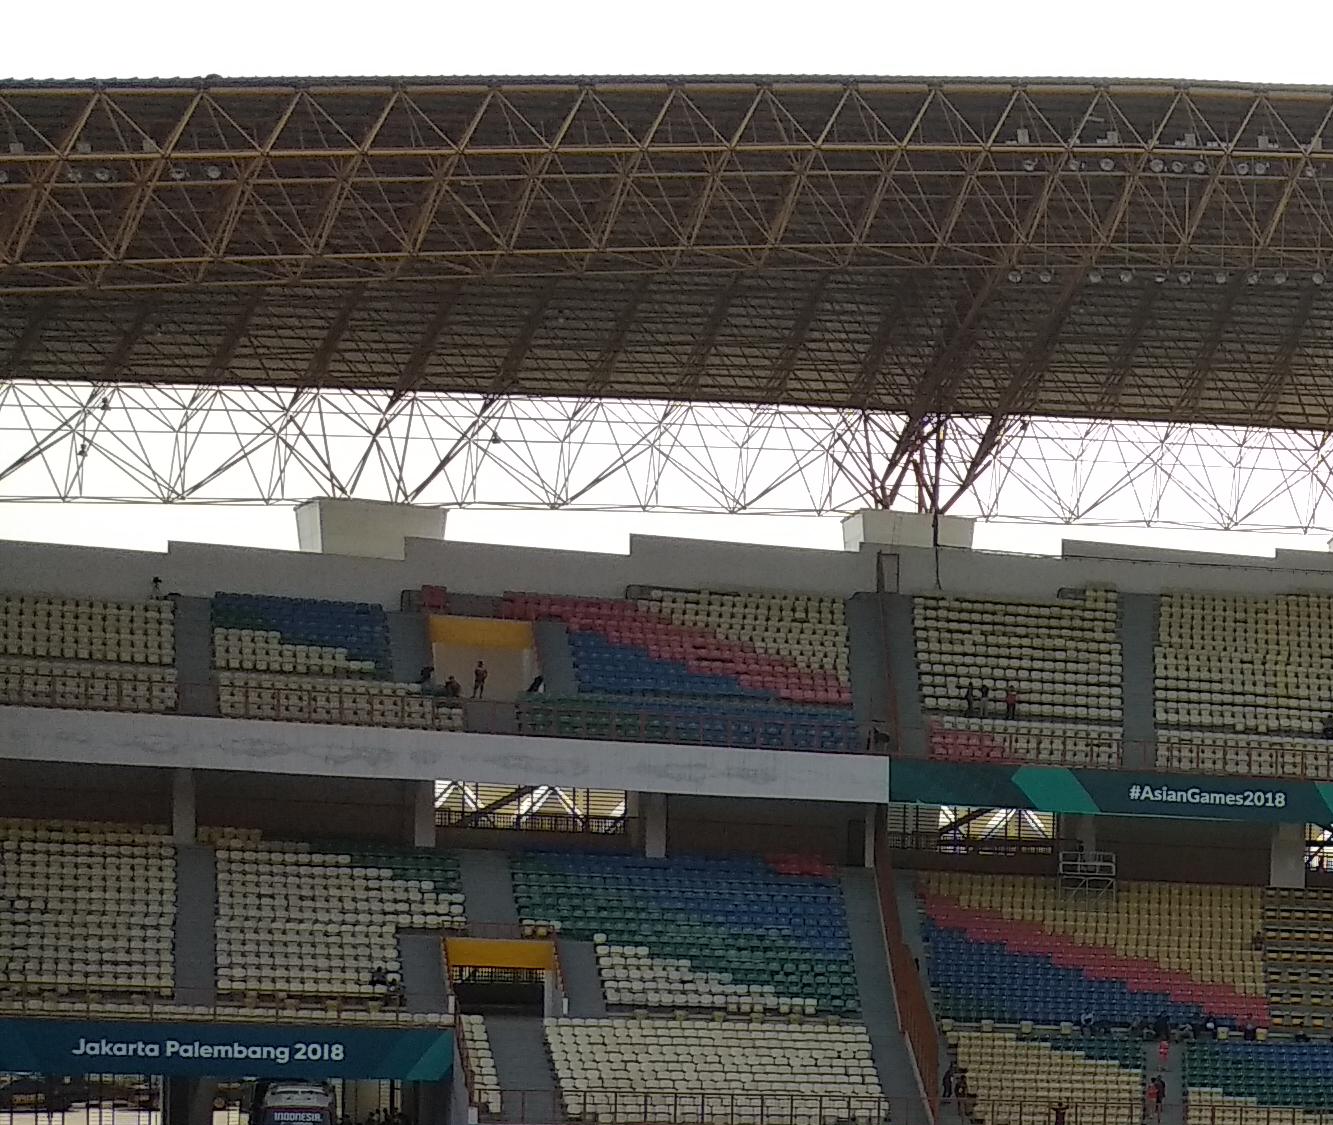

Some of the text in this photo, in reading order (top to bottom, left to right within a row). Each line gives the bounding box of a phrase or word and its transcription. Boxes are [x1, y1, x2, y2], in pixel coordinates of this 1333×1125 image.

[1129, 784, 1286, 808] #AsianGames2018
[72, 1038, 344, 1063] Jakarta Palembang 2018
